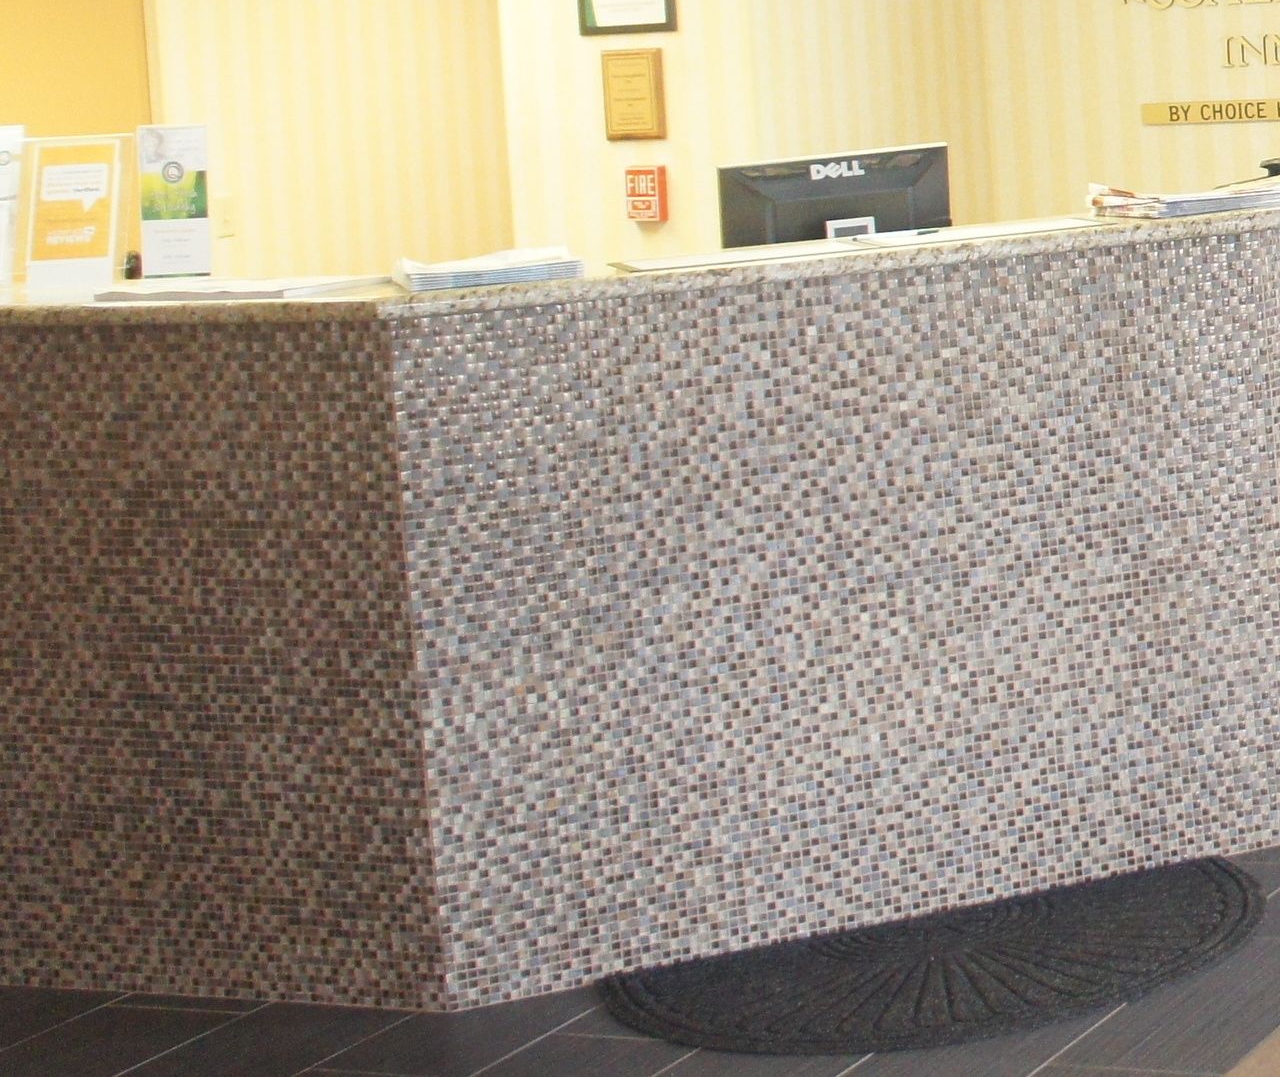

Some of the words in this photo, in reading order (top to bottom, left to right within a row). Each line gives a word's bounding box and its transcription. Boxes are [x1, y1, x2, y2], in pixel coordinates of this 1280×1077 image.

[1168, 105, 1191, 123] BY
[1200, 101, 1267, 121] CHOICE
[809, 159, 866, 181] DELL
[626, 174, 656, 195] FIRE
